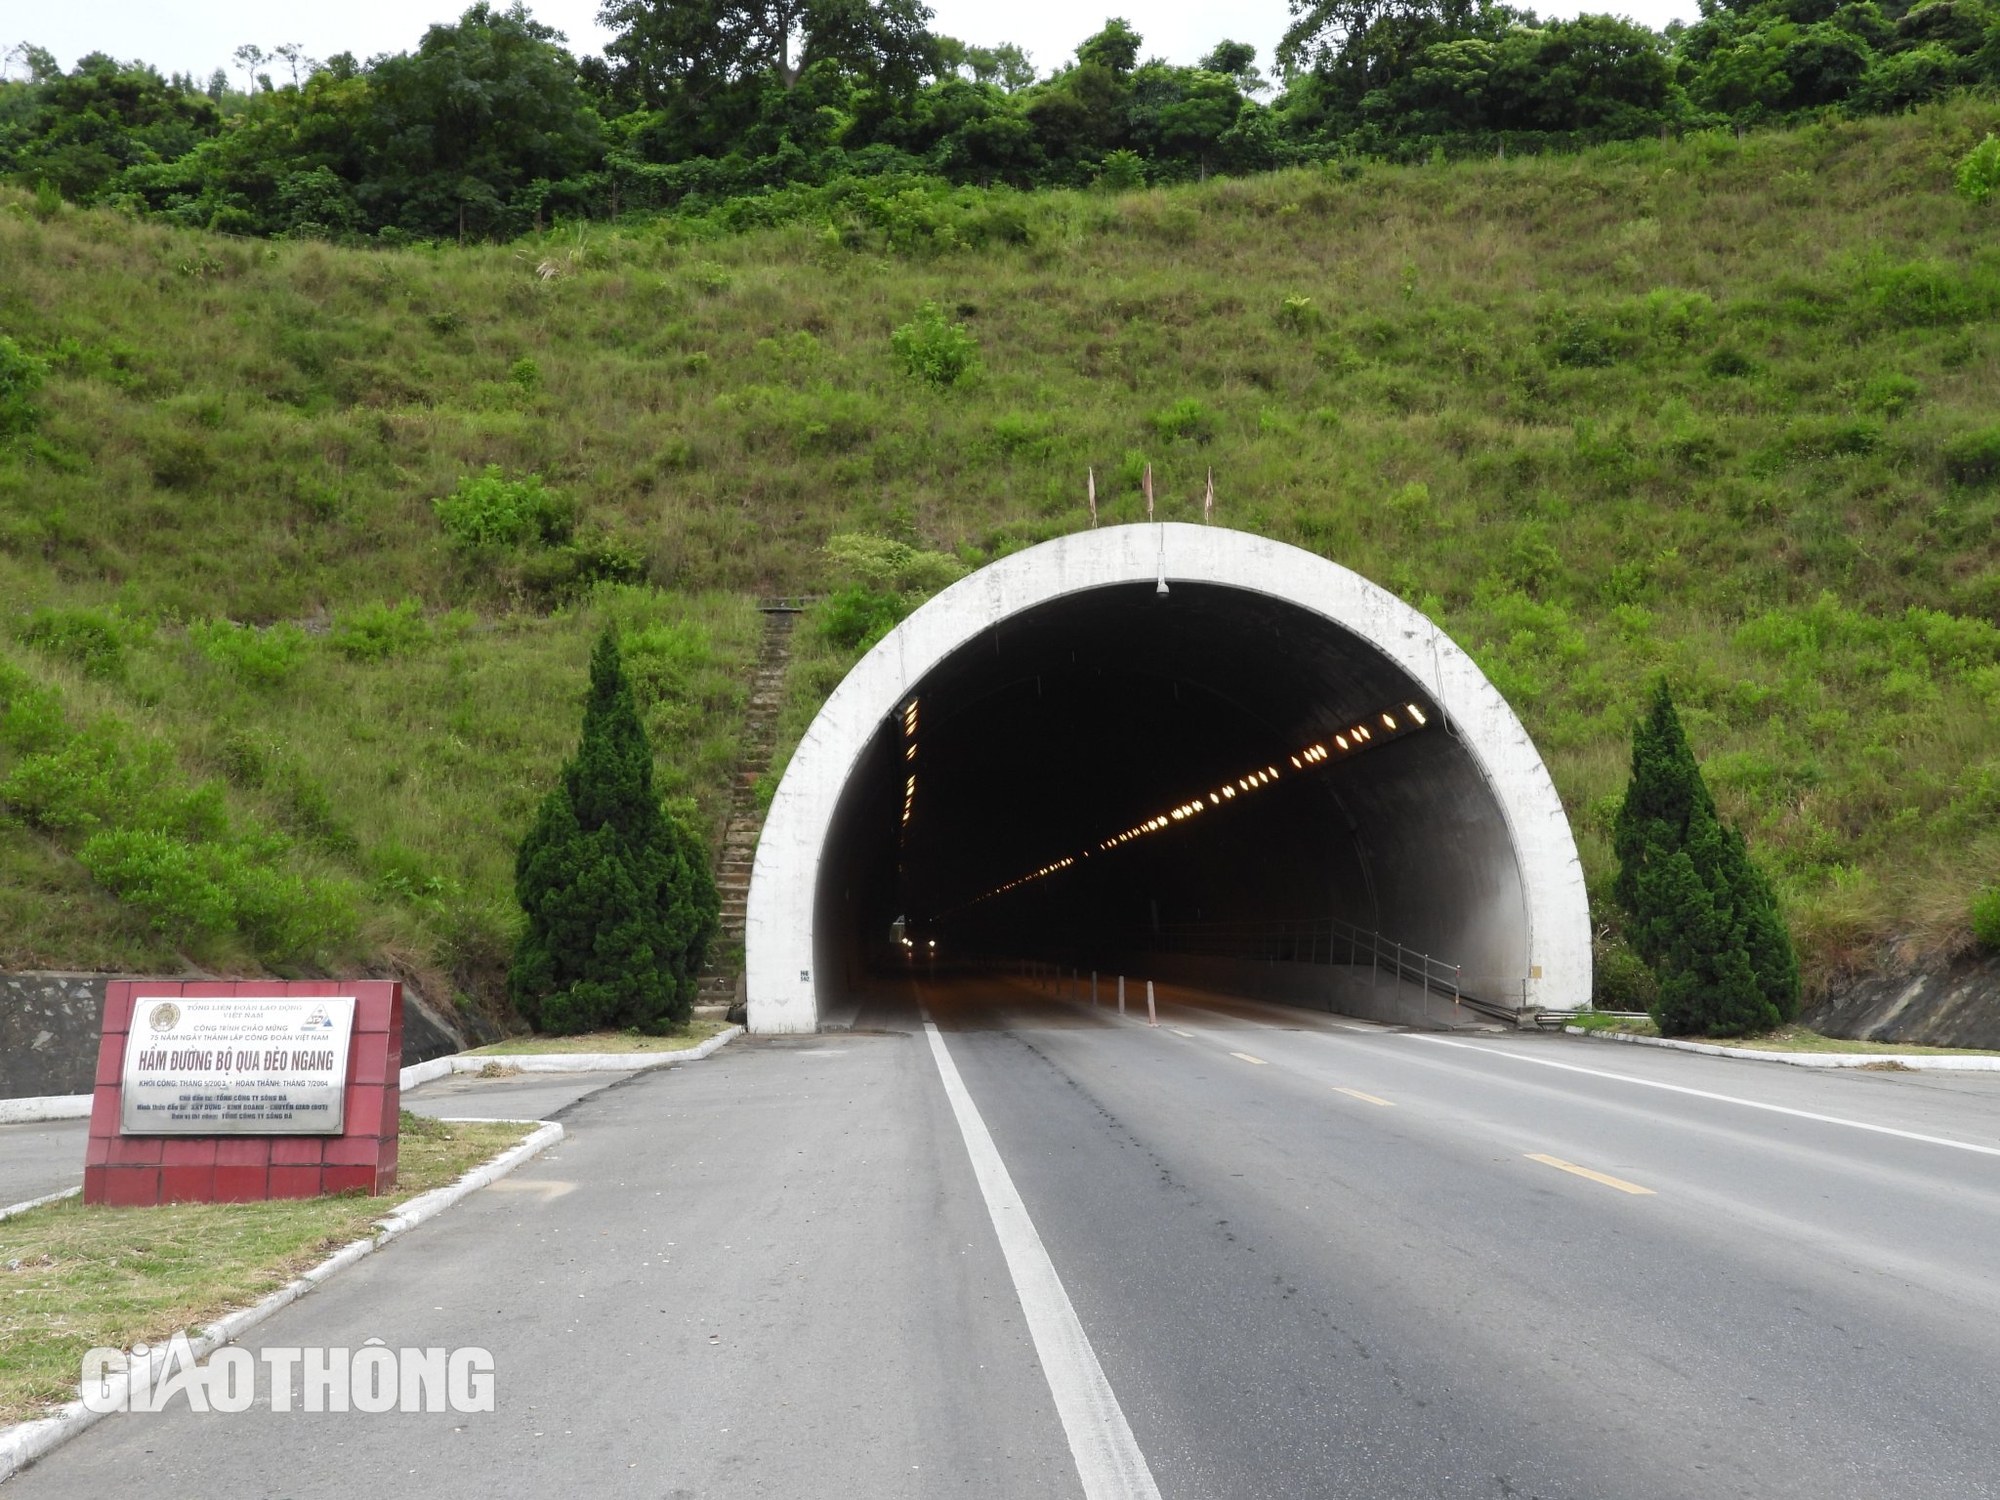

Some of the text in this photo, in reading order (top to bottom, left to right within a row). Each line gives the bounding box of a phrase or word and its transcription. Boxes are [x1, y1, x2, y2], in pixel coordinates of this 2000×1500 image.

[193, 1024, 217, 1032] CÔNG
[219, 1024, 240, 1032] TRÌNH
[241, 1024, 264, 1032] CHÀO
[180, 1033, 202, 1041] NGÀY
[204, 1033, 228, 1041] THÀNH
[270, 1033, 293, 1041] ĐOÀN
[295, 1033, 310, 1042] VIỆT
[138, 1043, 334, 1076] HẦM ĐƯỜNG BỘ QUA ĐÈO NGANG
[179, 1078, 203, 1087] THÁNG
[282, 1078, 306, 1087] THÁNG
[307, 1080, 329, 1088] 7/2004
